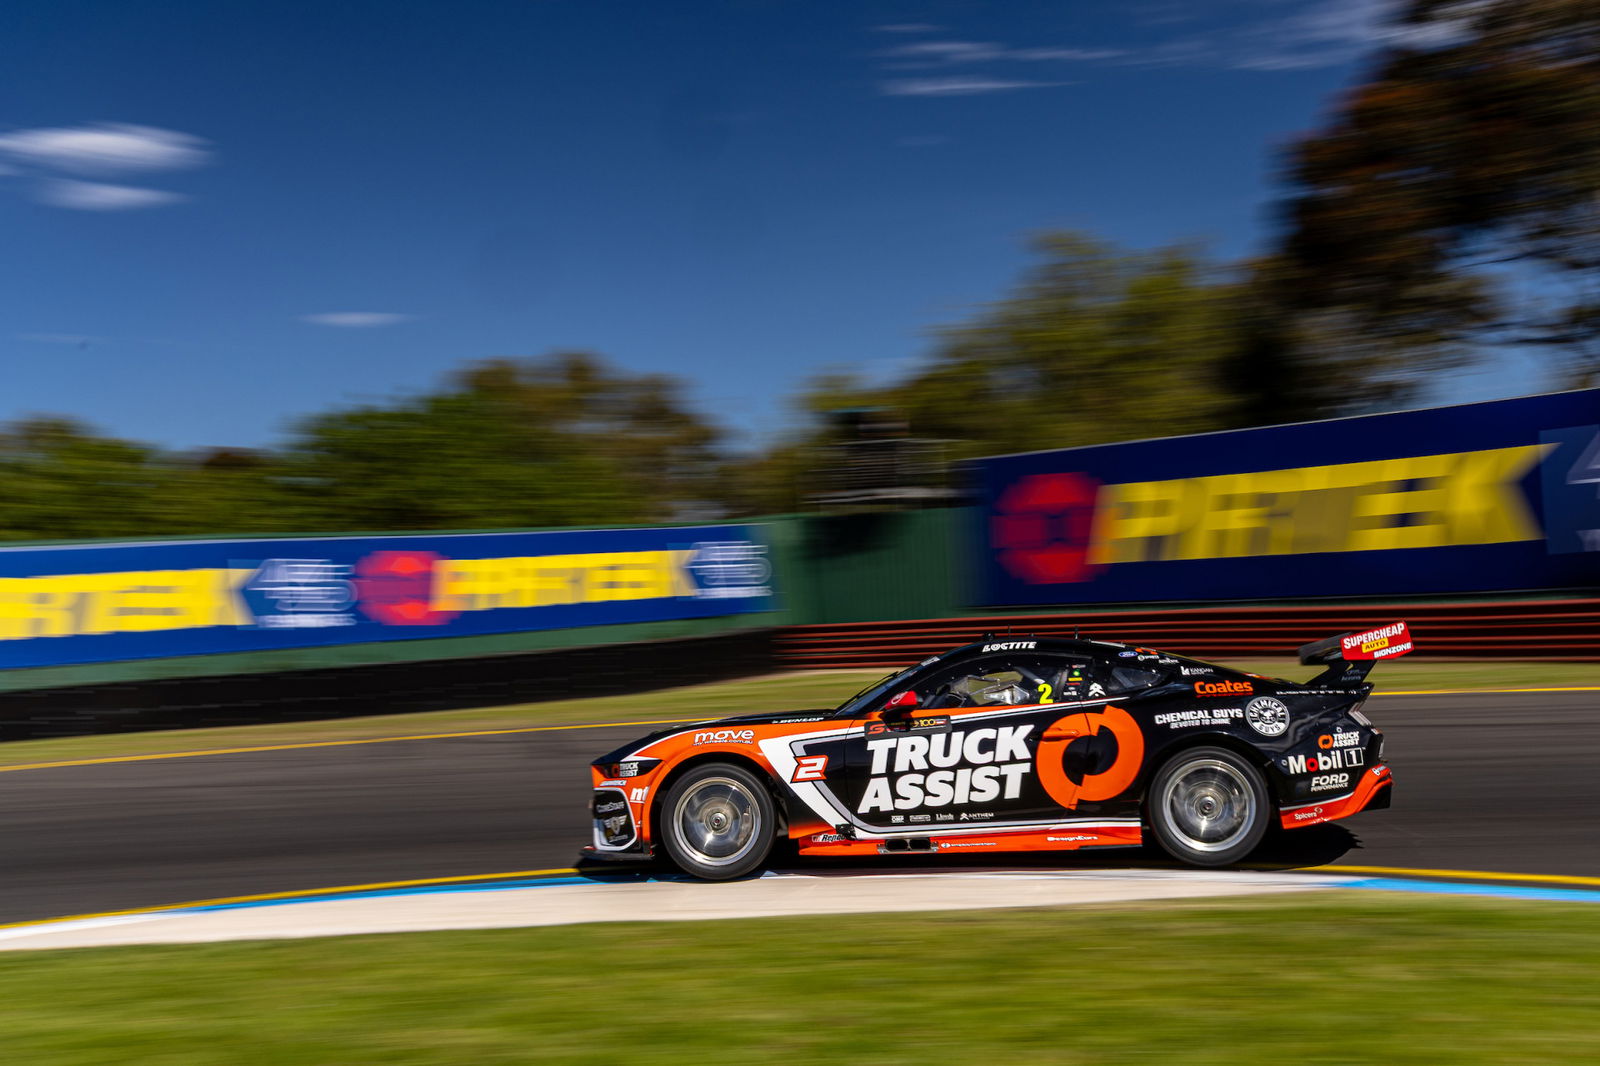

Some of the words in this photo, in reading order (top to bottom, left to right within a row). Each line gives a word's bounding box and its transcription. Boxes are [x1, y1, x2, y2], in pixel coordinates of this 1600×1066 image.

[1343, 622, 1405, 650] SUPERCHEAP
[982, 641, 1037, 652] LOCTITE
[1364, 640, 1386, 651] AUTO
[1037, 683, 1054, 704] 2
[1194, 680, 1254, 695] Coates
[1155, 710, 1211, 725] CHEMICAL
[1212, 708, 1244, 719] GUYS
[1249, 699, 1286, 719] CHEMICAL
[1258, 723, 1281, 733] GUYS
[1333, 731, 1360, 741] TRUCK
[694, 730, 754, 743] move
[1332, 740, 1360, 748] ASSIST
[867, 724, 1035, 775] TRUCK
[794, 757, 826, 780] 2
[1287, 751, 1343, 774] Mobil
[857, 762, 1031, 814] ASSIST
[1311, 773, 1349, 787] FORD
